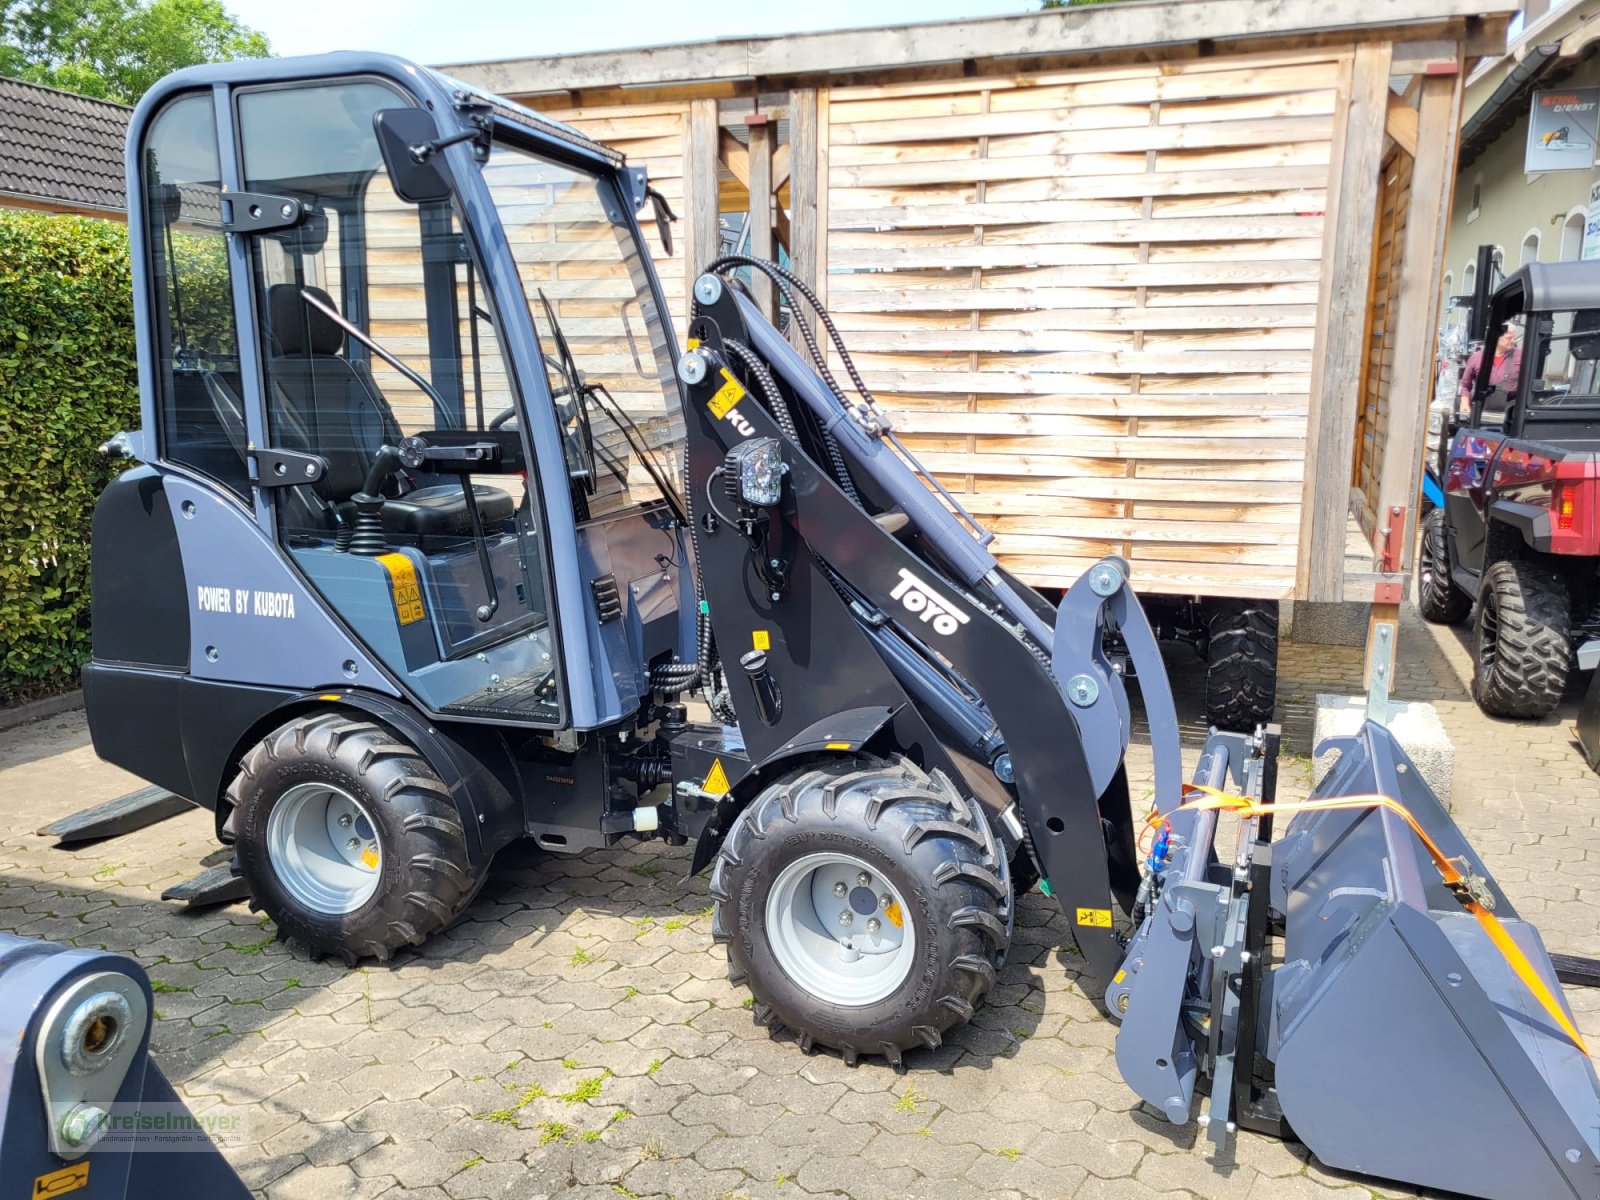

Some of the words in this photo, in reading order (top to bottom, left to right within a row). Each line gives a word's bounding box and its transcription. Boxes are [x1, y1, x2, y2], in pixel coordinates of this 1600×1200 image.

[1553, 103, 1596, 113] DIENST
[725, 408, 756, 437] KU
[197, 586, 232, 614] POWER
[235, 589, 250, 615] BY
[254, 591, 295, 619] KUBOTA
[889, 567, 971, 636] TOYO
